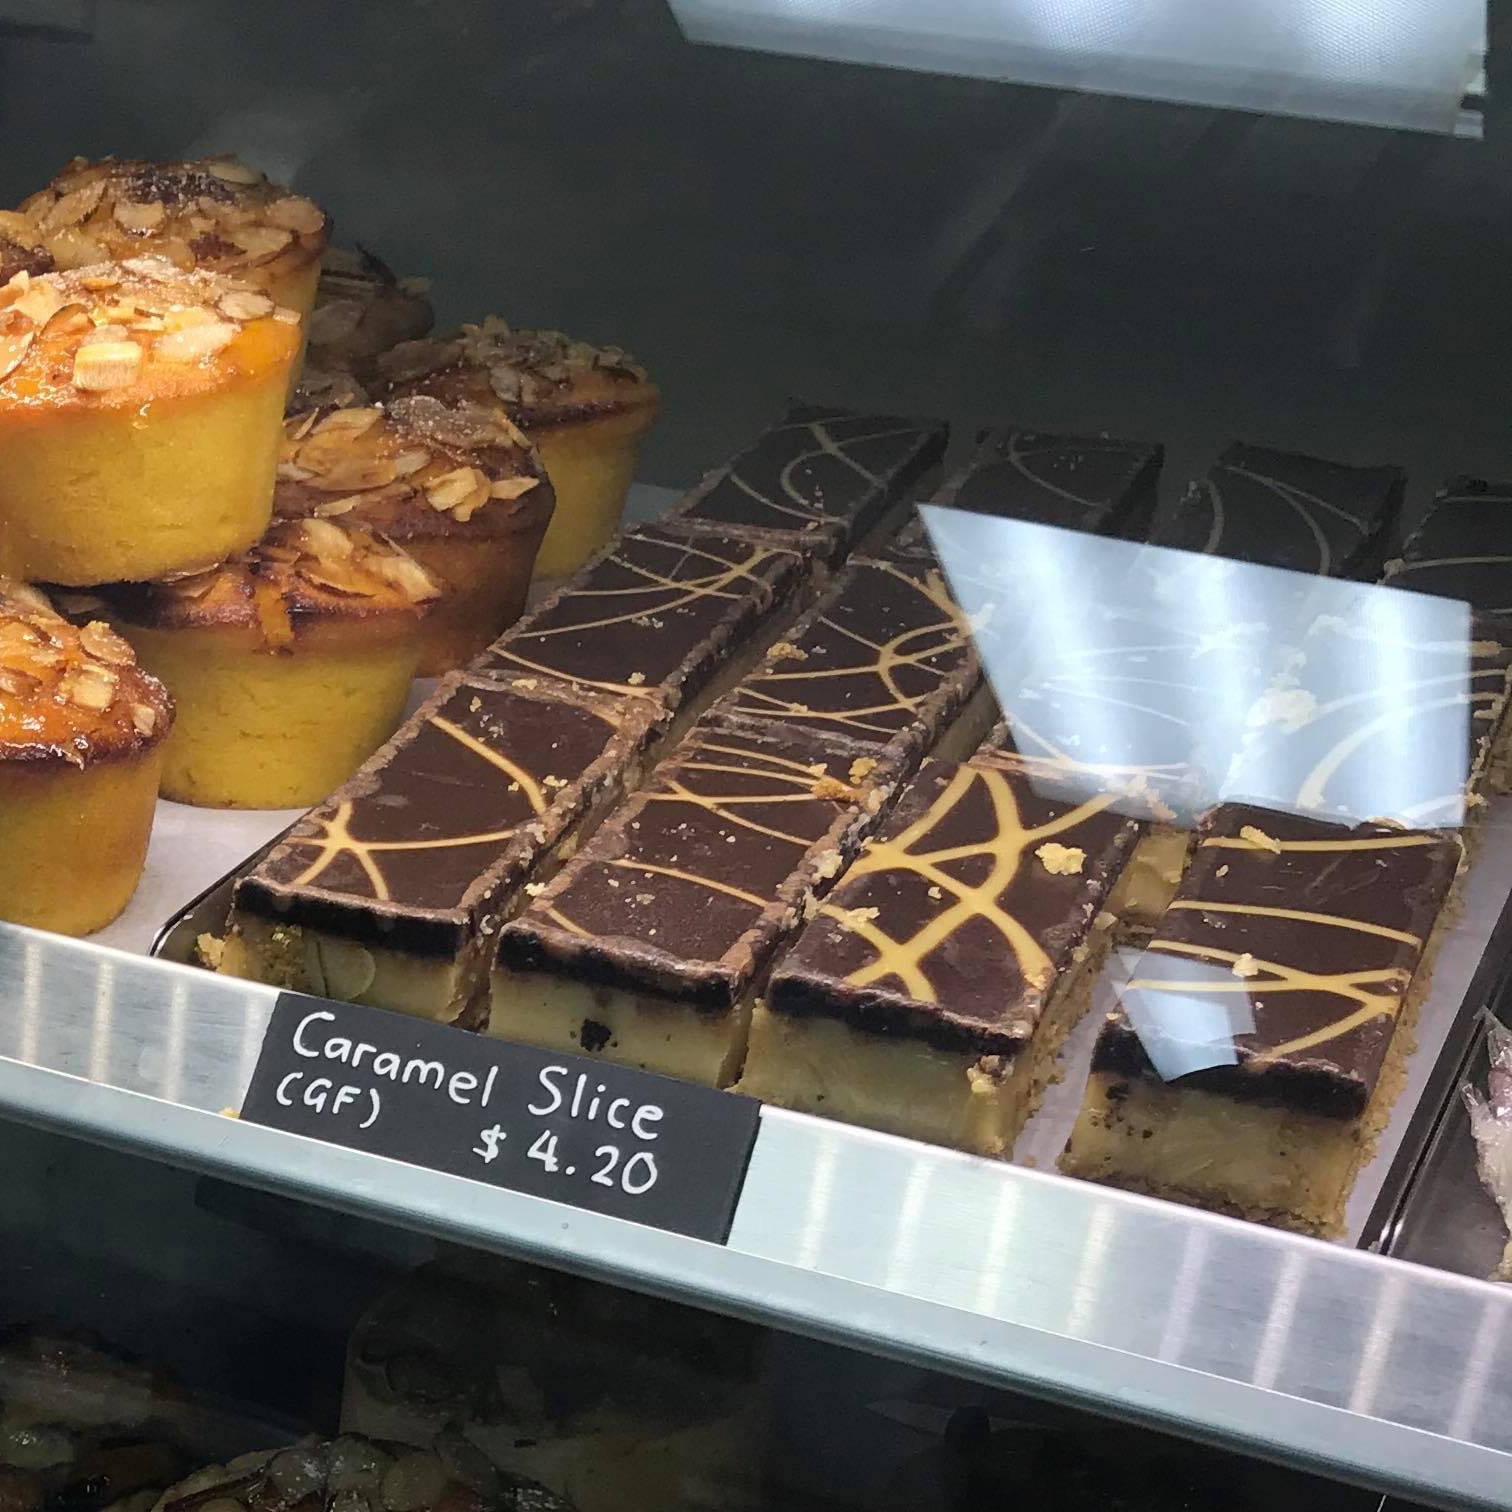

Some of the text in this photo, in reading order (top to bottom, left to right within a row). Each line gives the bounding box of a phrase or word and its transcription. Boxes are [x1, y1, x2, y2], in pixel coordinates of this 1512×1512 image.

[276, 1072, 381, 1129] (GF)
[291, 1011, 665, 1141] Caramel Slice
